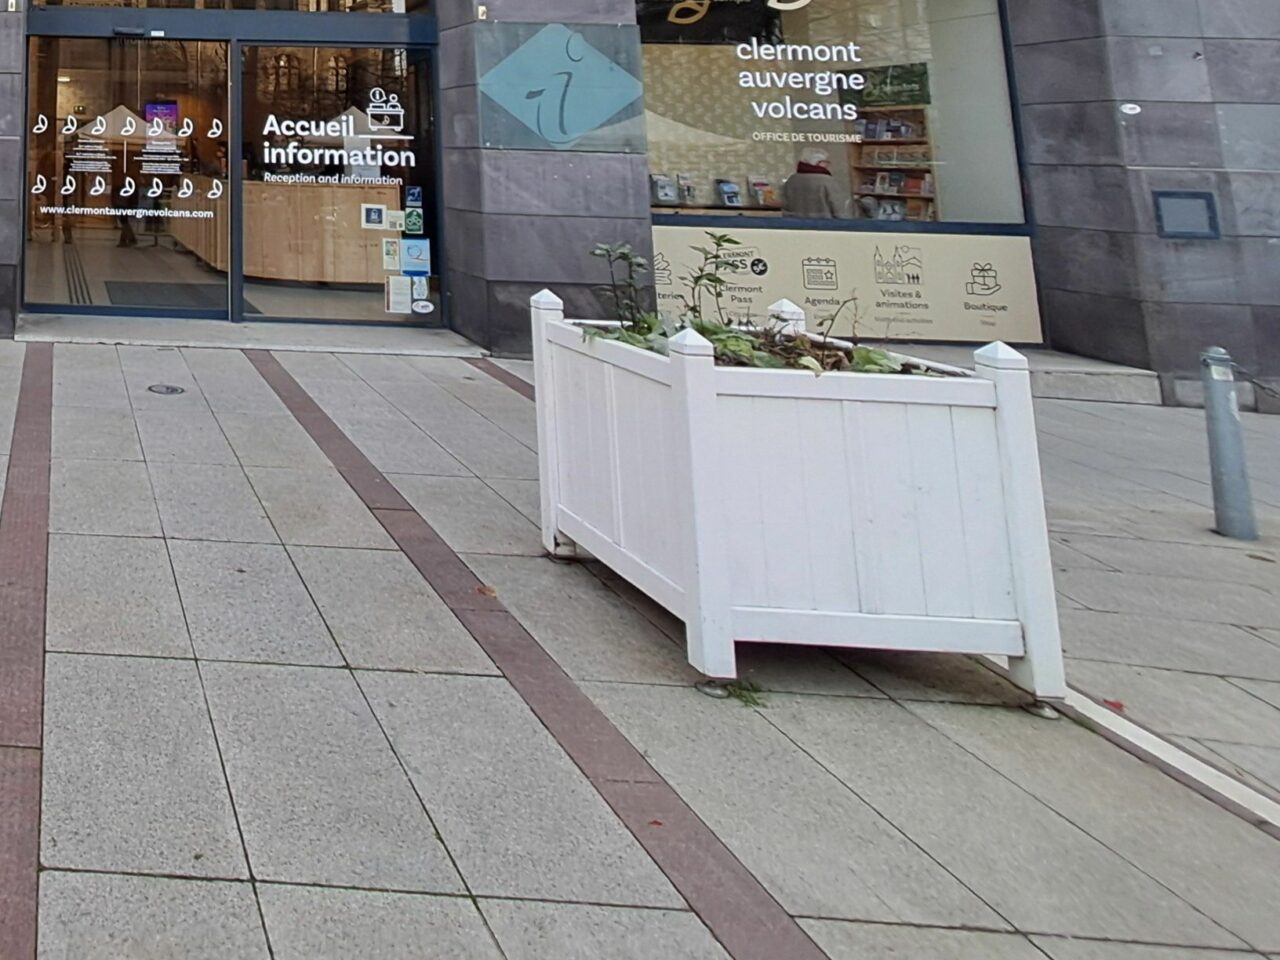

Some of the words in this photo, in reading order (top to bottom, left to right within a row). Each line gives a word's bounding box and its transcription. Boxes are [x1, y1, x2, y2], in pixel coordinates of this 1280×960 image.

[736, 37, 861, 62] clermont
[738, 69, 865, 95] auvergne
[751, 96, 858, 121] volcans
[263, 114, 355, 137] Accueil
[752, 131, 790, 142] OFFICE
[791, 132, 806, 142] DE
[806, 132, 862, 143] TOURISME
[263, 142, 416, 168] information
[264, 172, 316, 185] Reception
[318, 173, 339, 185] and
[341, 174, 403, 186] information
[39, 204, 214, 219] www.clermontauvergnevolcans.com
[719, 251, 754, 260] ERMONT
[720, 284, 764, 294] Clermont
[880, 289, 914, 299] Visites
[730, 295, 753, 303] Pass
[804, 296, 841, 307] Agenda
[875, 300, 930, 311] animations
[964, 302, 1008, 312] Boutique
